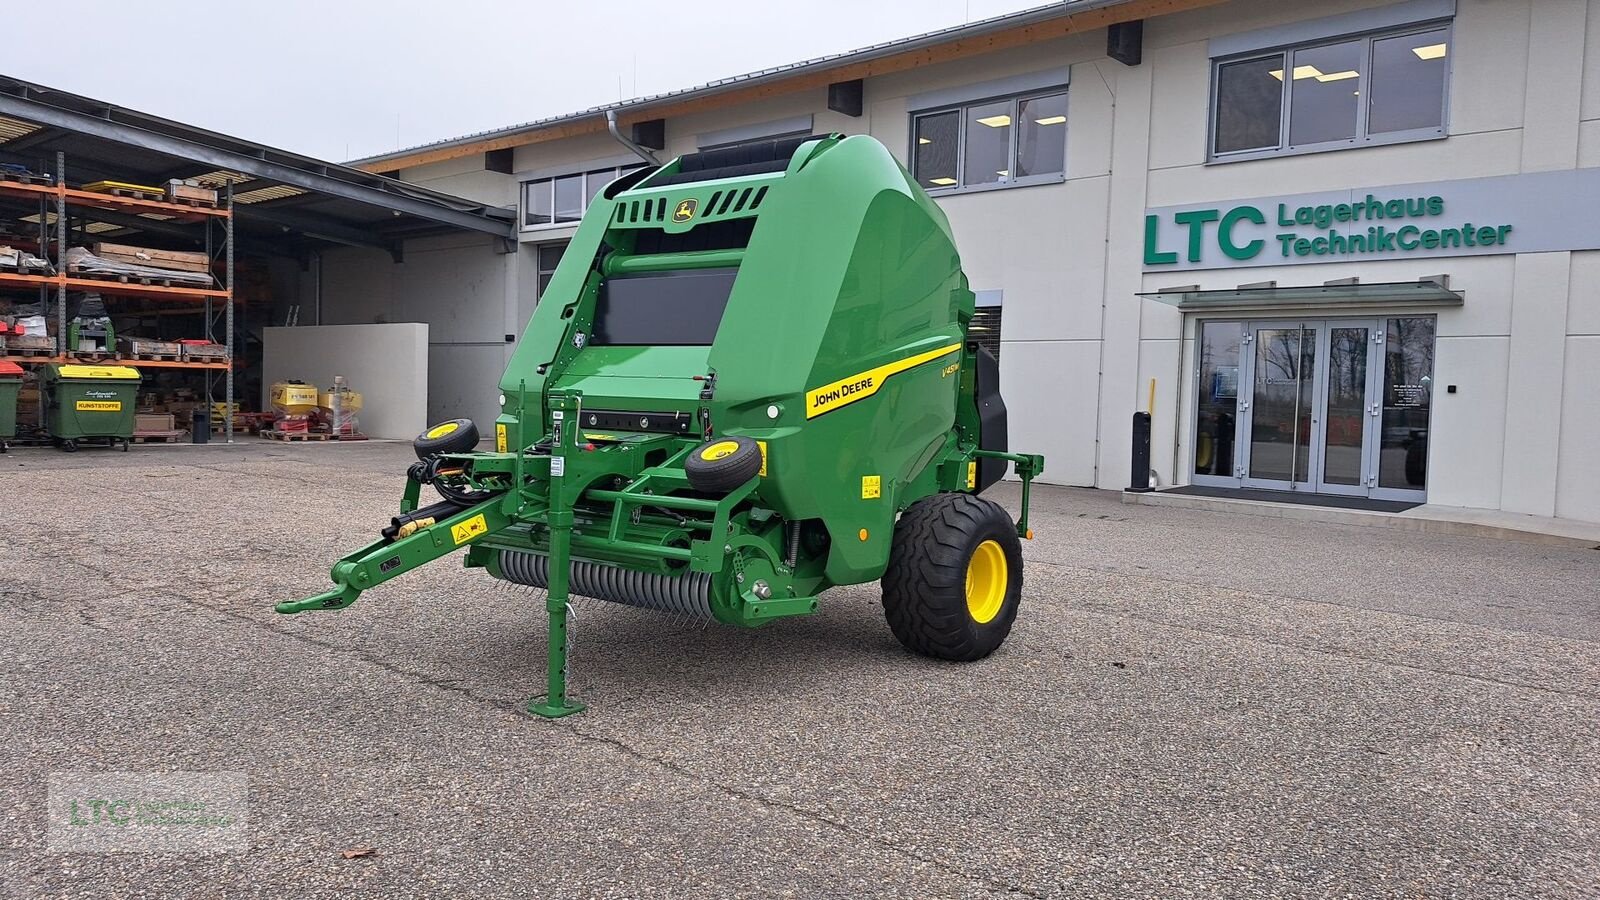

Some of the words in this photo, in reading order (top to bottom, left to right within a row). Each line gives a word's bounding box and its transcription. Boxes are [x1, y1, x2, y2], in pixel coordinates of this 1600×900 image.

[1278, 194, 1444, 229] Lagerhaus
[1144, 206, 1266, 265] LTC
[1276, 223, 1512, 257] TechnikCenter
[813, 390, 840, 408] JOHN
[841, 377, 873, 397] DEERE
